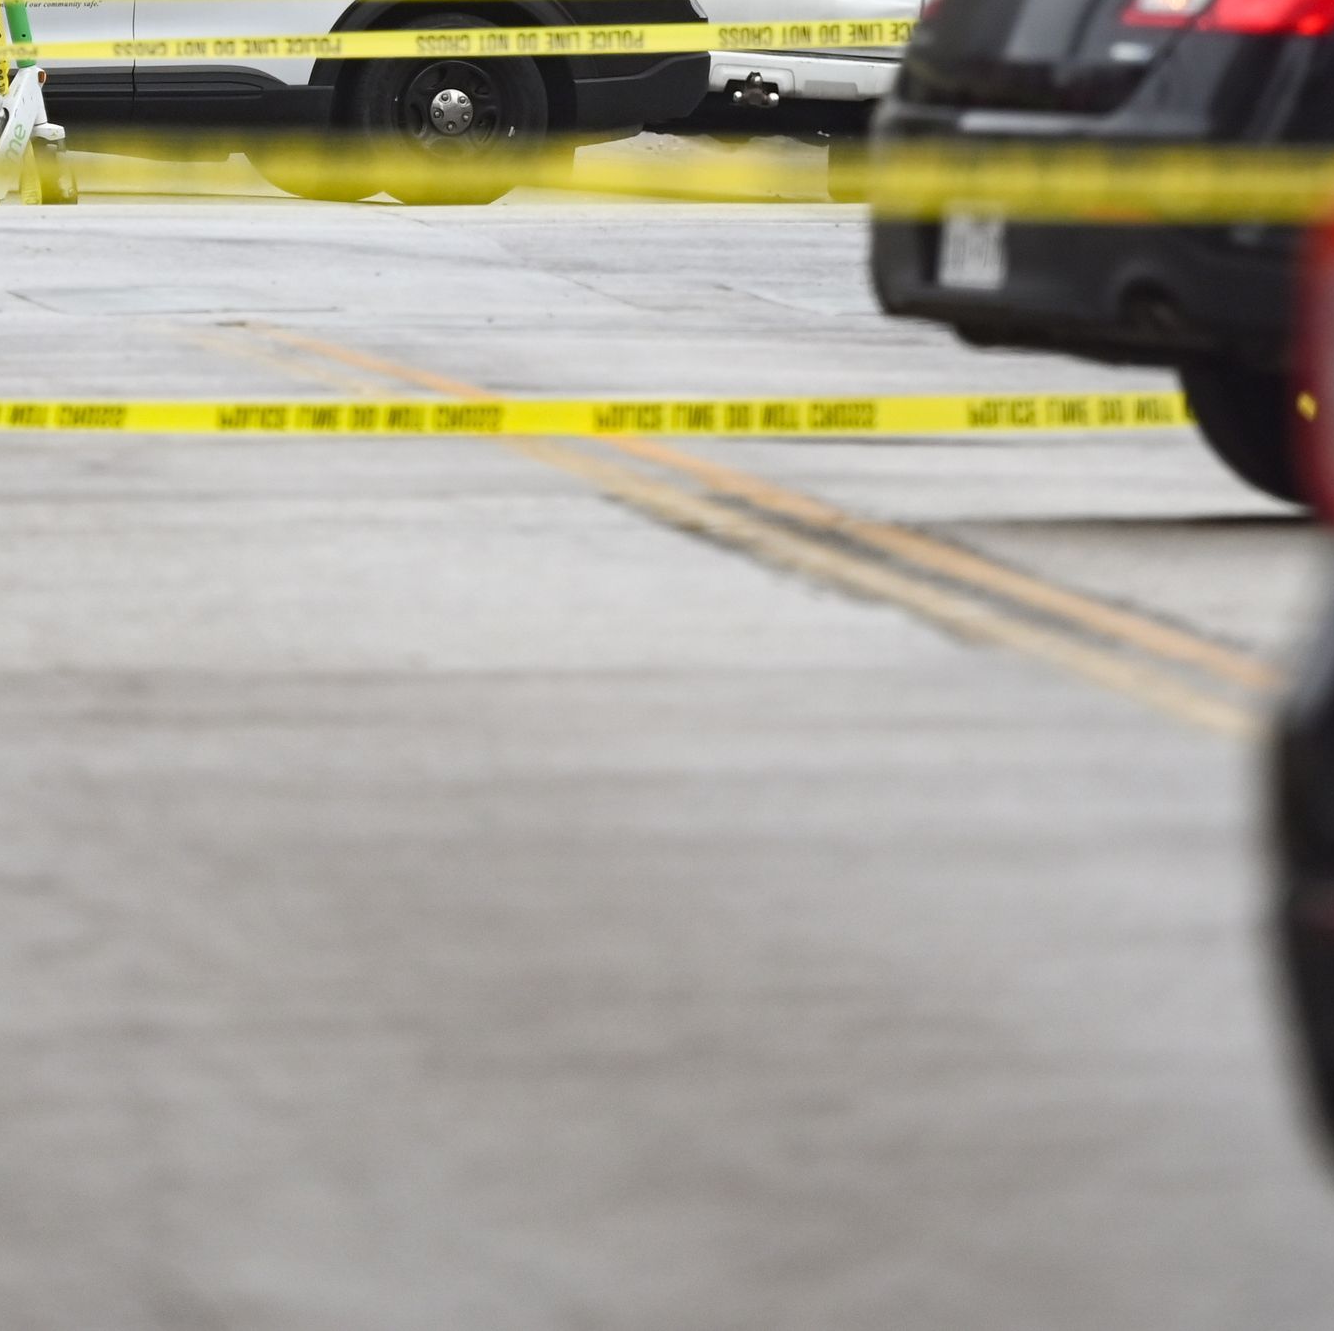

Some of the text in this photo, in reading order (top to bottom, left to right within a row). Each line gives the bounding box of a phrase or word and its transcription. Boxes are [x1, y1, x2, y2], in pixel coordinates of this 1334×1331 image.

[43, 1, 82, 10] community
[718, 27, 773, 46] CROSS
[781, 26, 811, 44] NOT
[818, 25, 841, 43] DO
[848, 23, 883, 41] LINE
